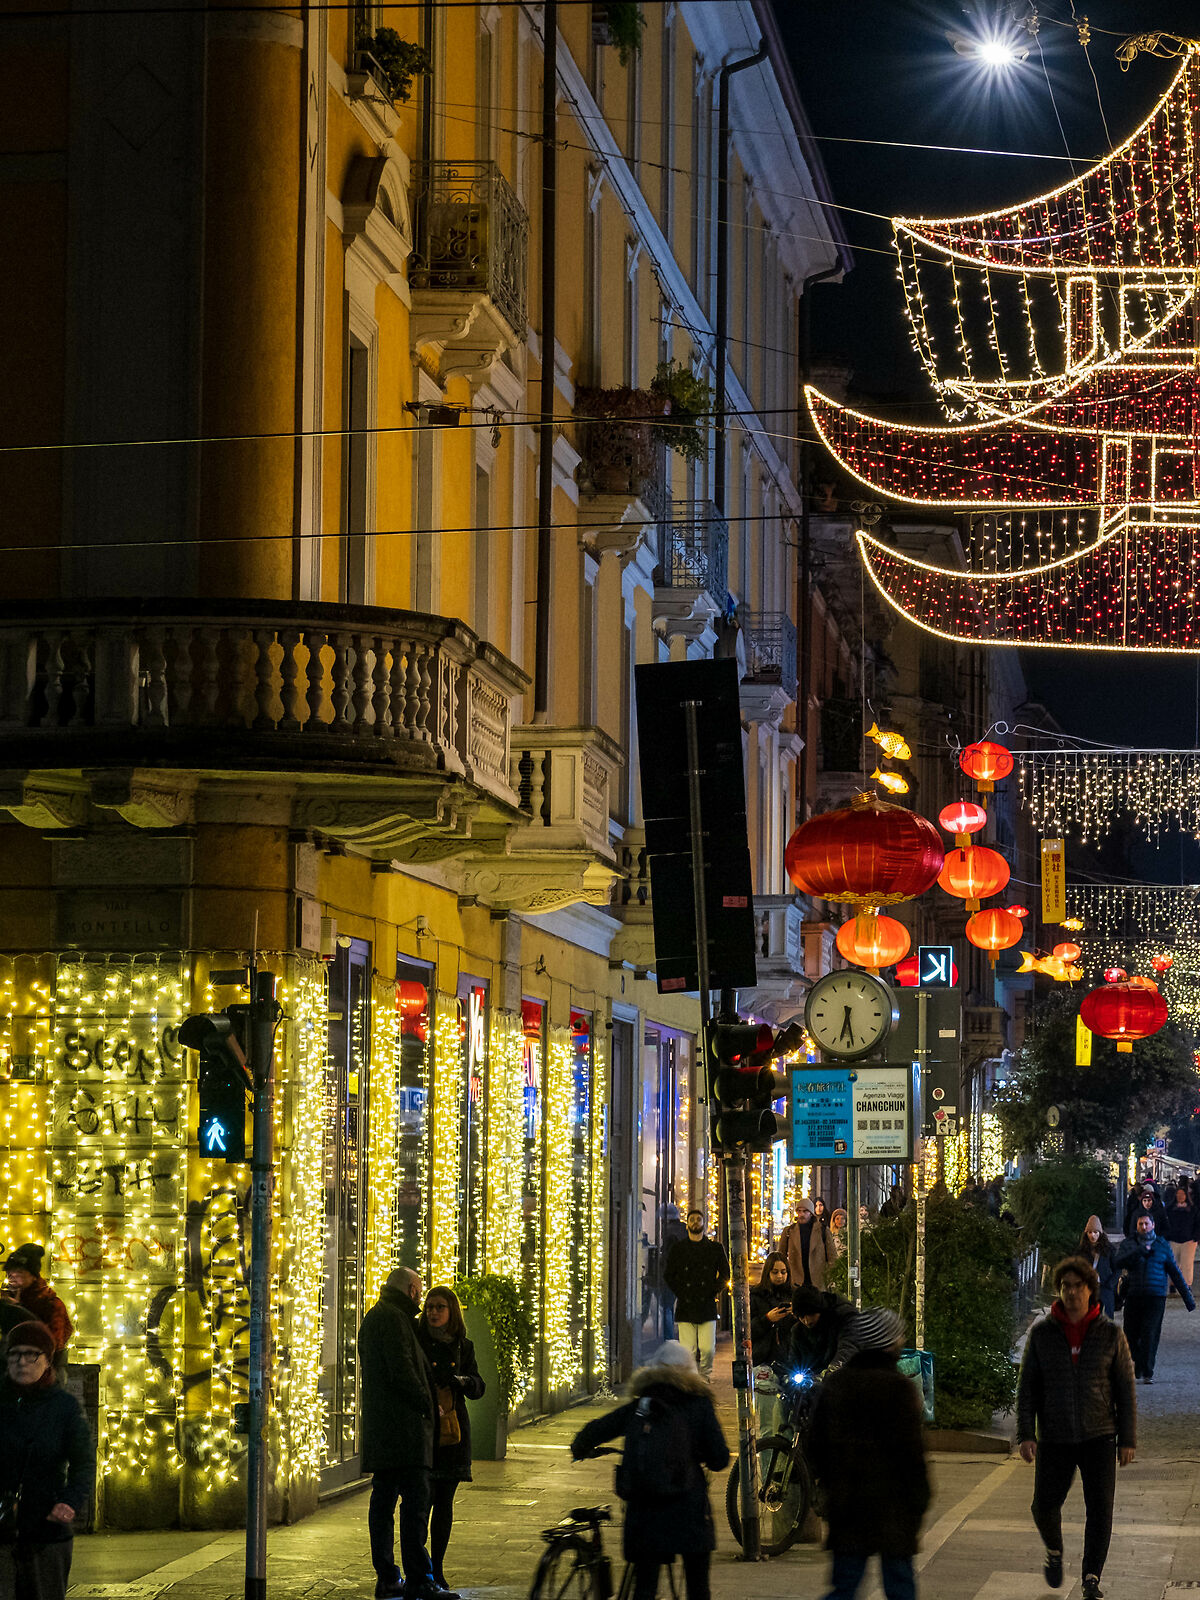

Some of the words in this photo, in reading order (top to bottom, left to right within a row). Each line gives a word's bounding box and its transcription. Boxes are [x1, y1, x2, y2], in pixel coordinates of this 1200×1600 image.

[65, 920, 170, 933] MONTELLO
[863, 1092, 886, 1100] Agenzia
[887, 1092, 905, 1100] Viaggi
[856, 1100, 906, 1112] CHANGCHUN
